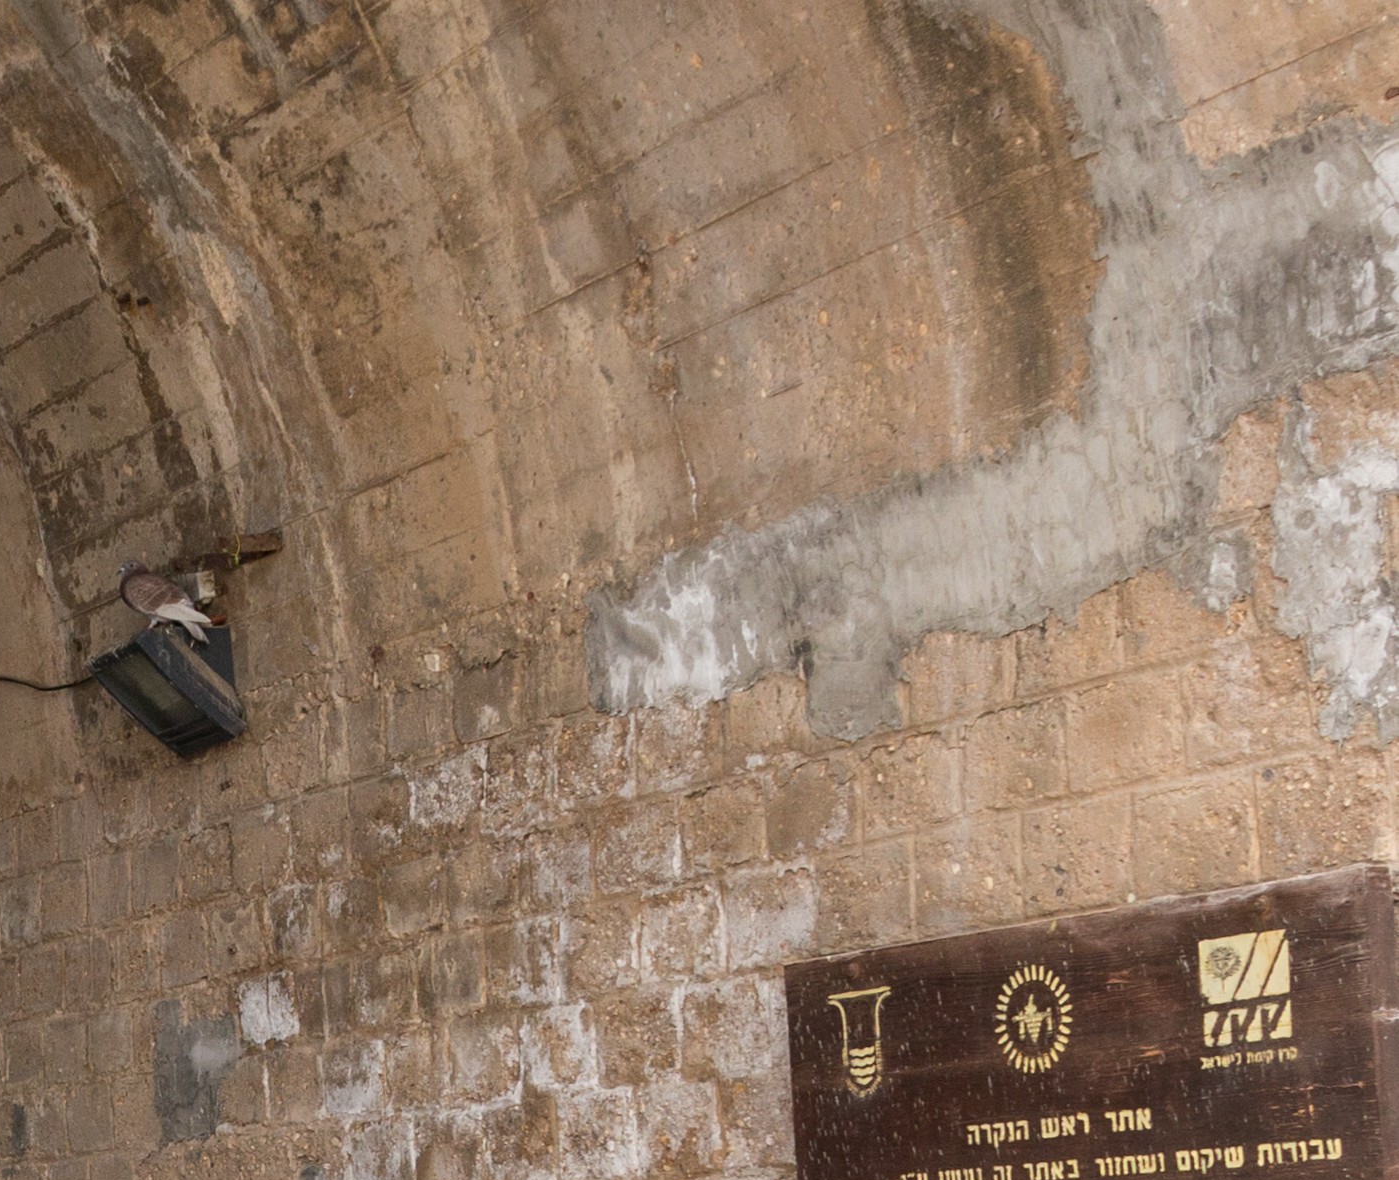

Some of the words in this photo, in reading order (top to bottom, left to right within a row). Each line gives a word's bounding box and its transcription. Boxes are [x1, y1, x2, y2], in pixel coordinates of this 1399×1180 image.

[967, 1119, 1029, 1148] הנקרה
[1041, 1112, 1090, 1139] ראש
[1105, 1108, 1152, 1132] אתר
[1095, 1153, 1165, 1176] ושחזור
[1176, 1146, 1244, 1174] שיקום
[1258, 1138, 1342, 1166] עבודות
[1023, 1159, 1080, 1180] באתר
